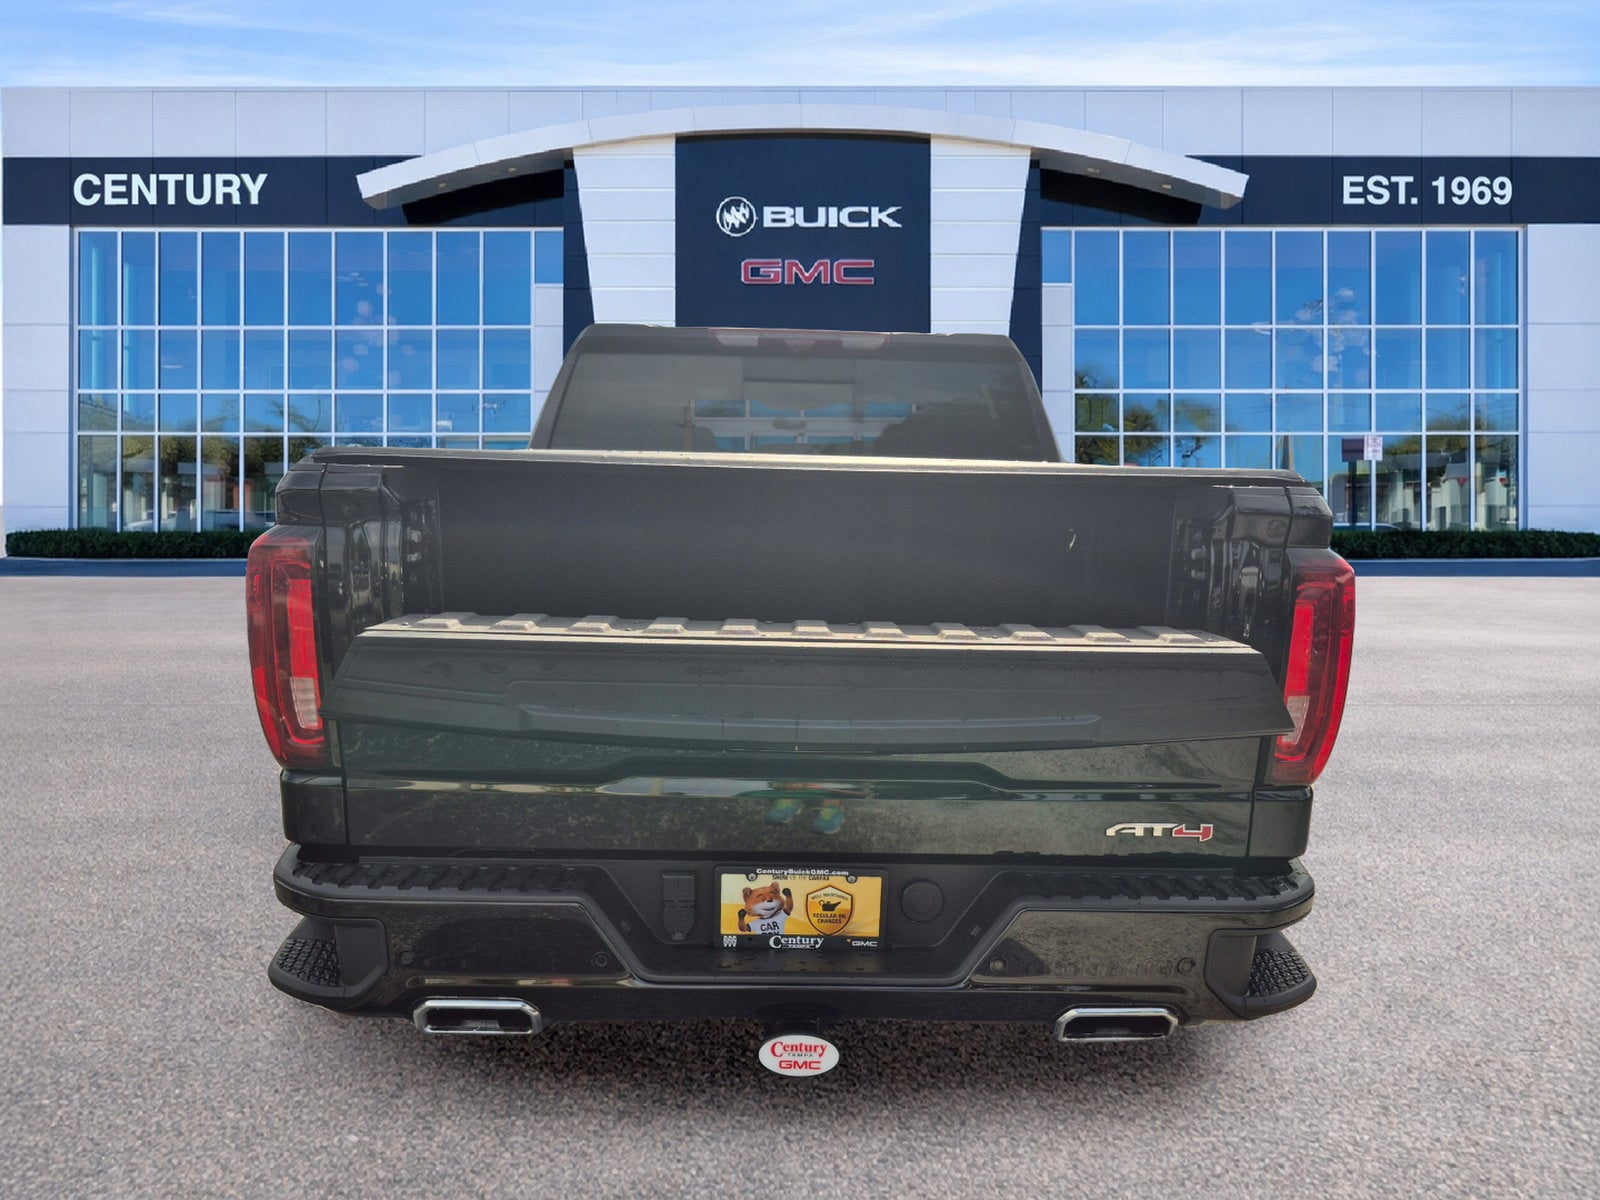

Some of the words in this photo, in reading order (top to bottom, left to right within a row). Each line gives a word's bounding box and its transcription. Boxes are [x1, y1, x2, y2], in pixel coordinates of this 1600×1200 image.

[73, 173, 268, 206] CENTURY
[1342, 175, 1419, 205] EST.
[1431, 175, 1513, 205] 1969
[762, 206, 903, 228] BUICK
[741, 258, 875, 285] GMC
[1106, 823, 1214, 842] AT4
[760, 921, 780, 931] CAR
[769, 935, 824, 949] Century
[770, 1041, 828, 1058] Century
[778, 1060, 822, 1070] GMC
